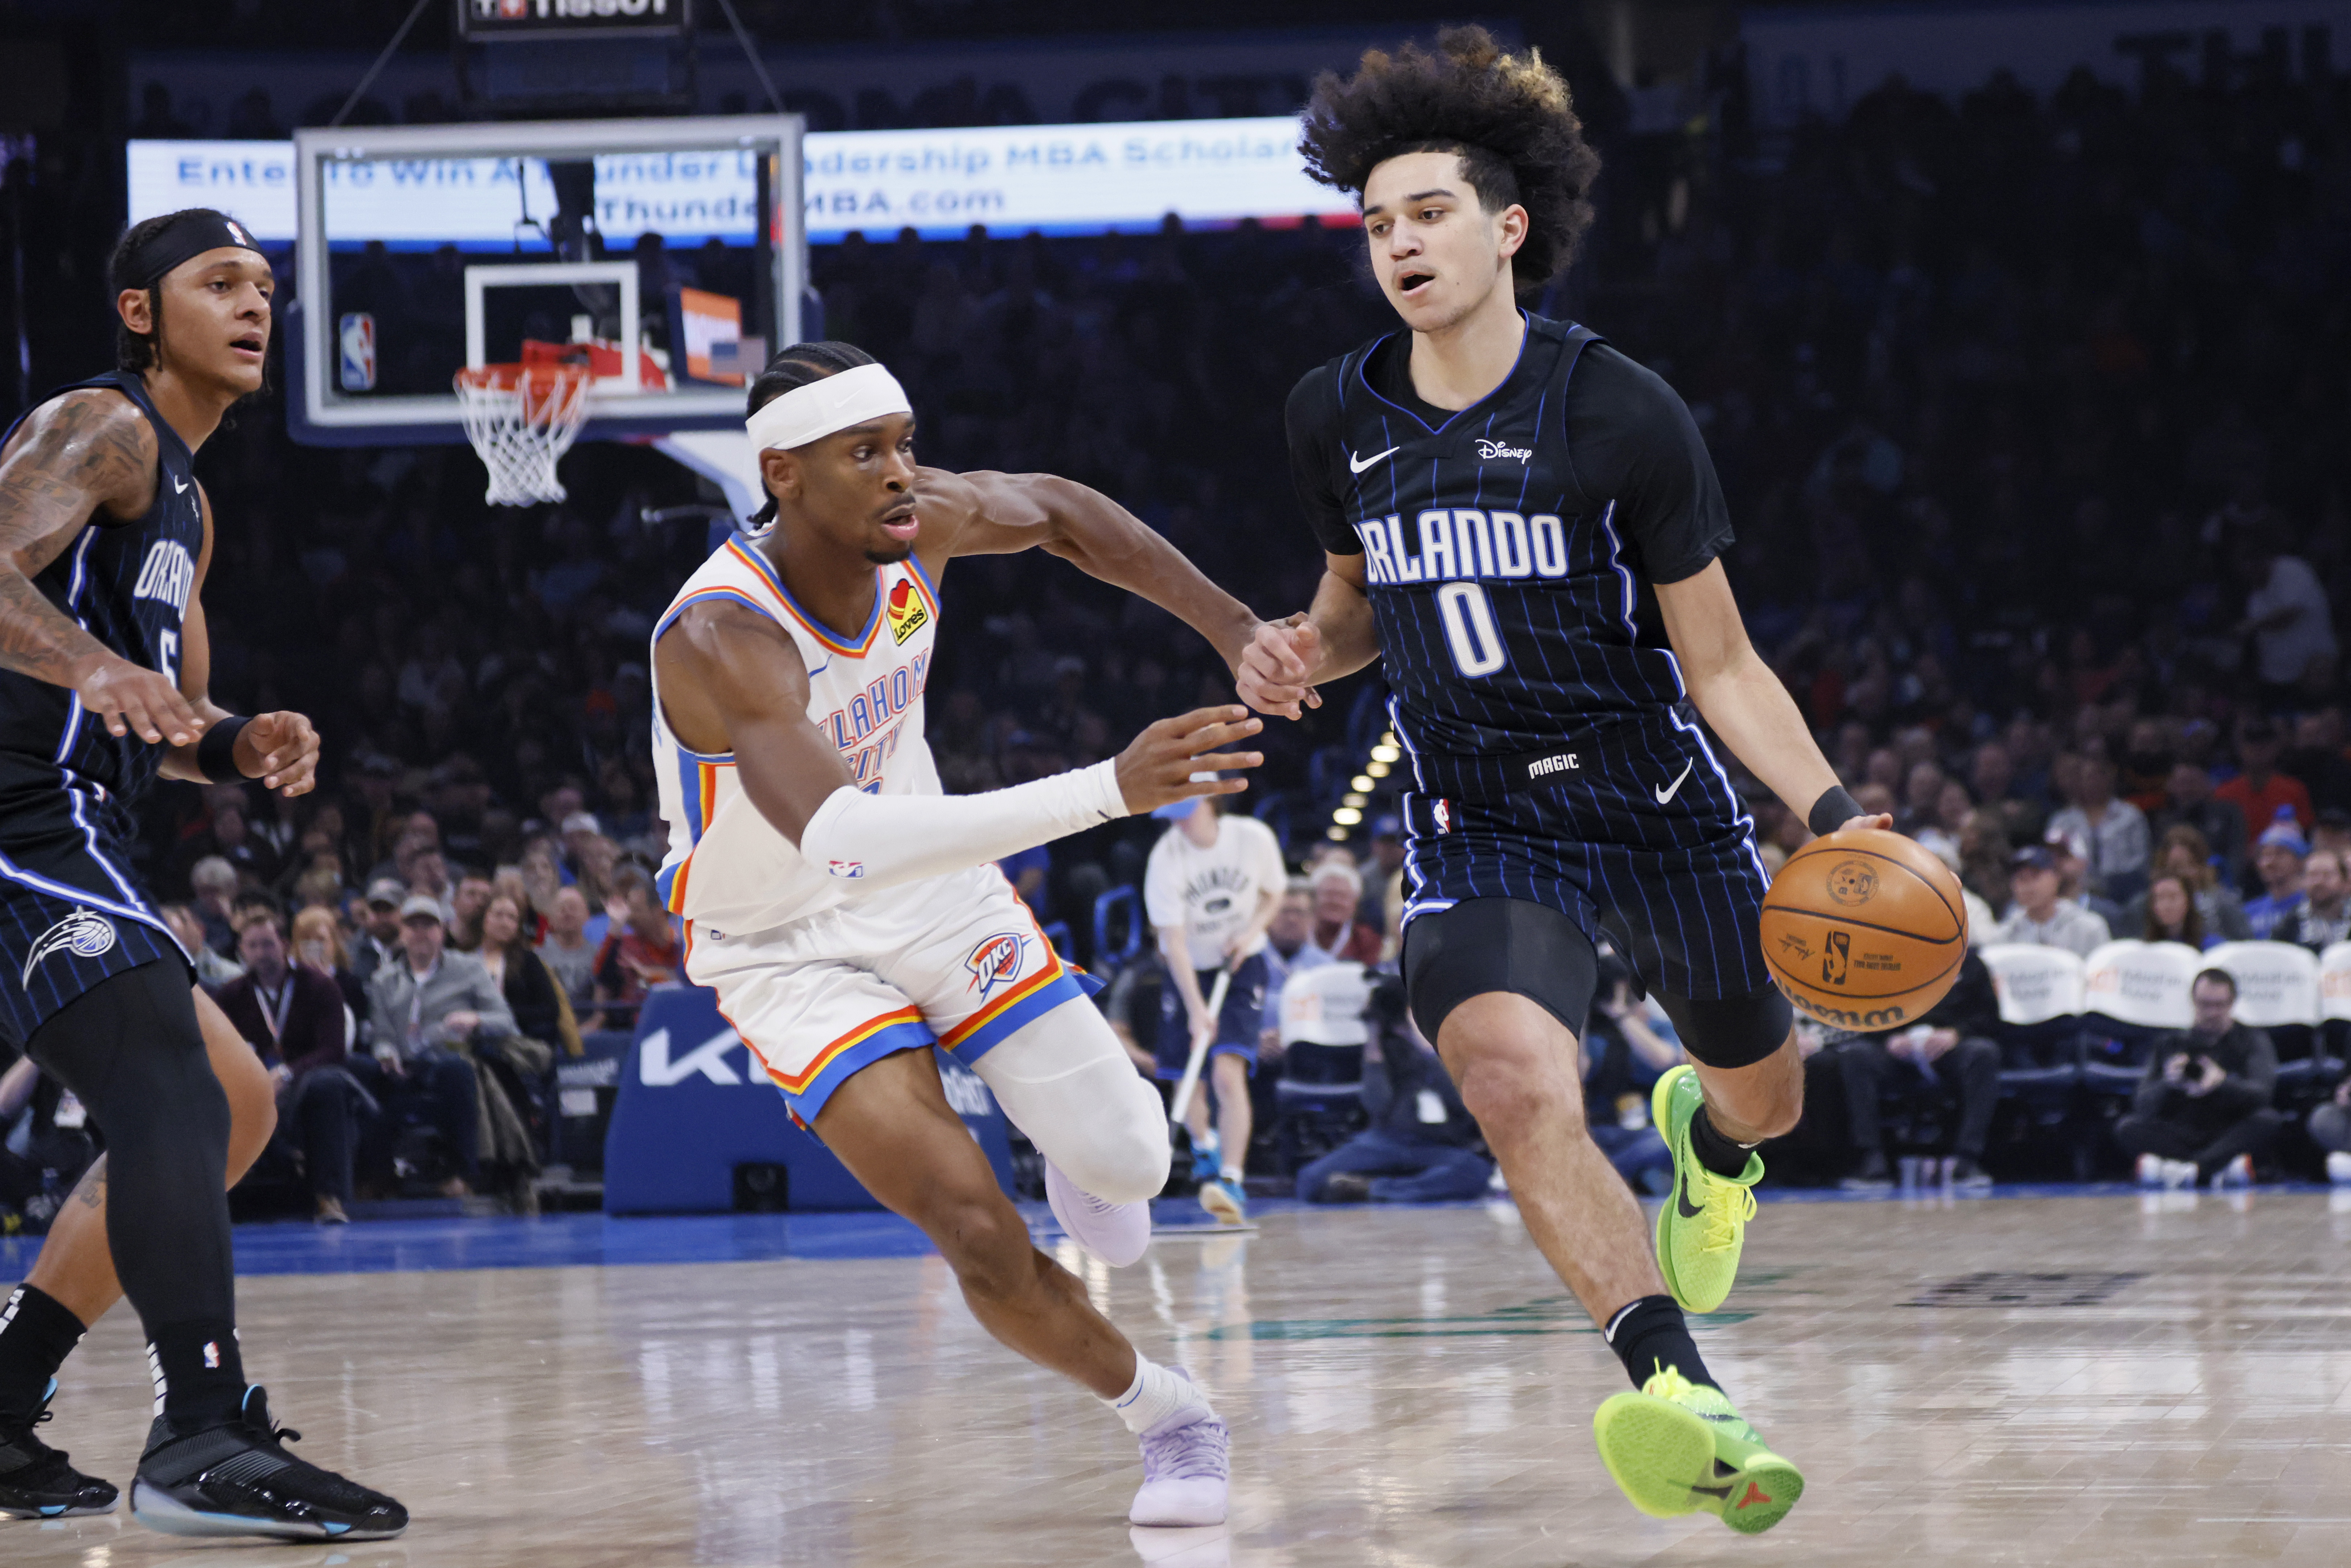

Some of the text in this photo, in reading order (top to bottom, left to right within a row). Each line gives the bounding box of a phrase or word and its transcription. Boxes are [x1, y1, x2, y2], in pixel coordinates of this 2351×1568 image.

[178, 155, 292, 188] Ente
[1437, 580, 1508, 679] 0
[1528, 753, 1580, 779] MAGIC
[977, 938, 1012, 994] OKC
